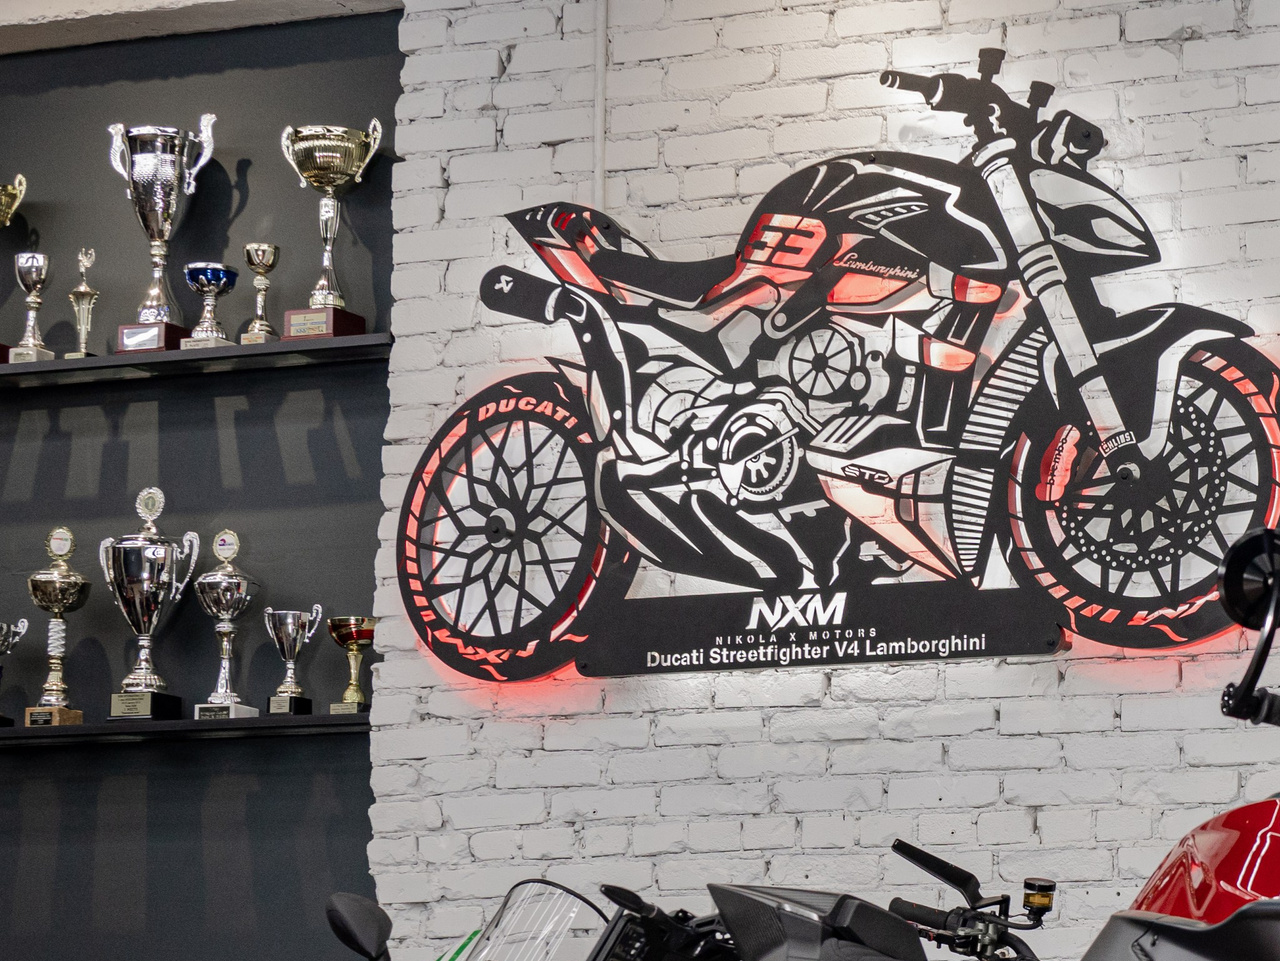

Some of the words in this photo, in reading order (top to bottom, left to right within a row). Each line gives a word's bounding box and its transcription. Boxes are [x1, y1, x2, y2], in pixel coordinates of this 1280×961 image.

[833, 252, 920, 279] Lamborghini
[477, 397, 578, 429] DUCATI
[1045, 437, 1068, 485] brembo
[746, 592, 847, 632] NXM
[646, 646, 704, 668] Ducati
[709, 642, 830, 665] Streetfighter
[835, 641, 860, 659] V4
[865, 633, 987, 658] Lamborghini
[715, 634, 778, 646] NIKOLA
[789, 631, 797, 642] X
[809, 628, 877, 641] MOTORS
